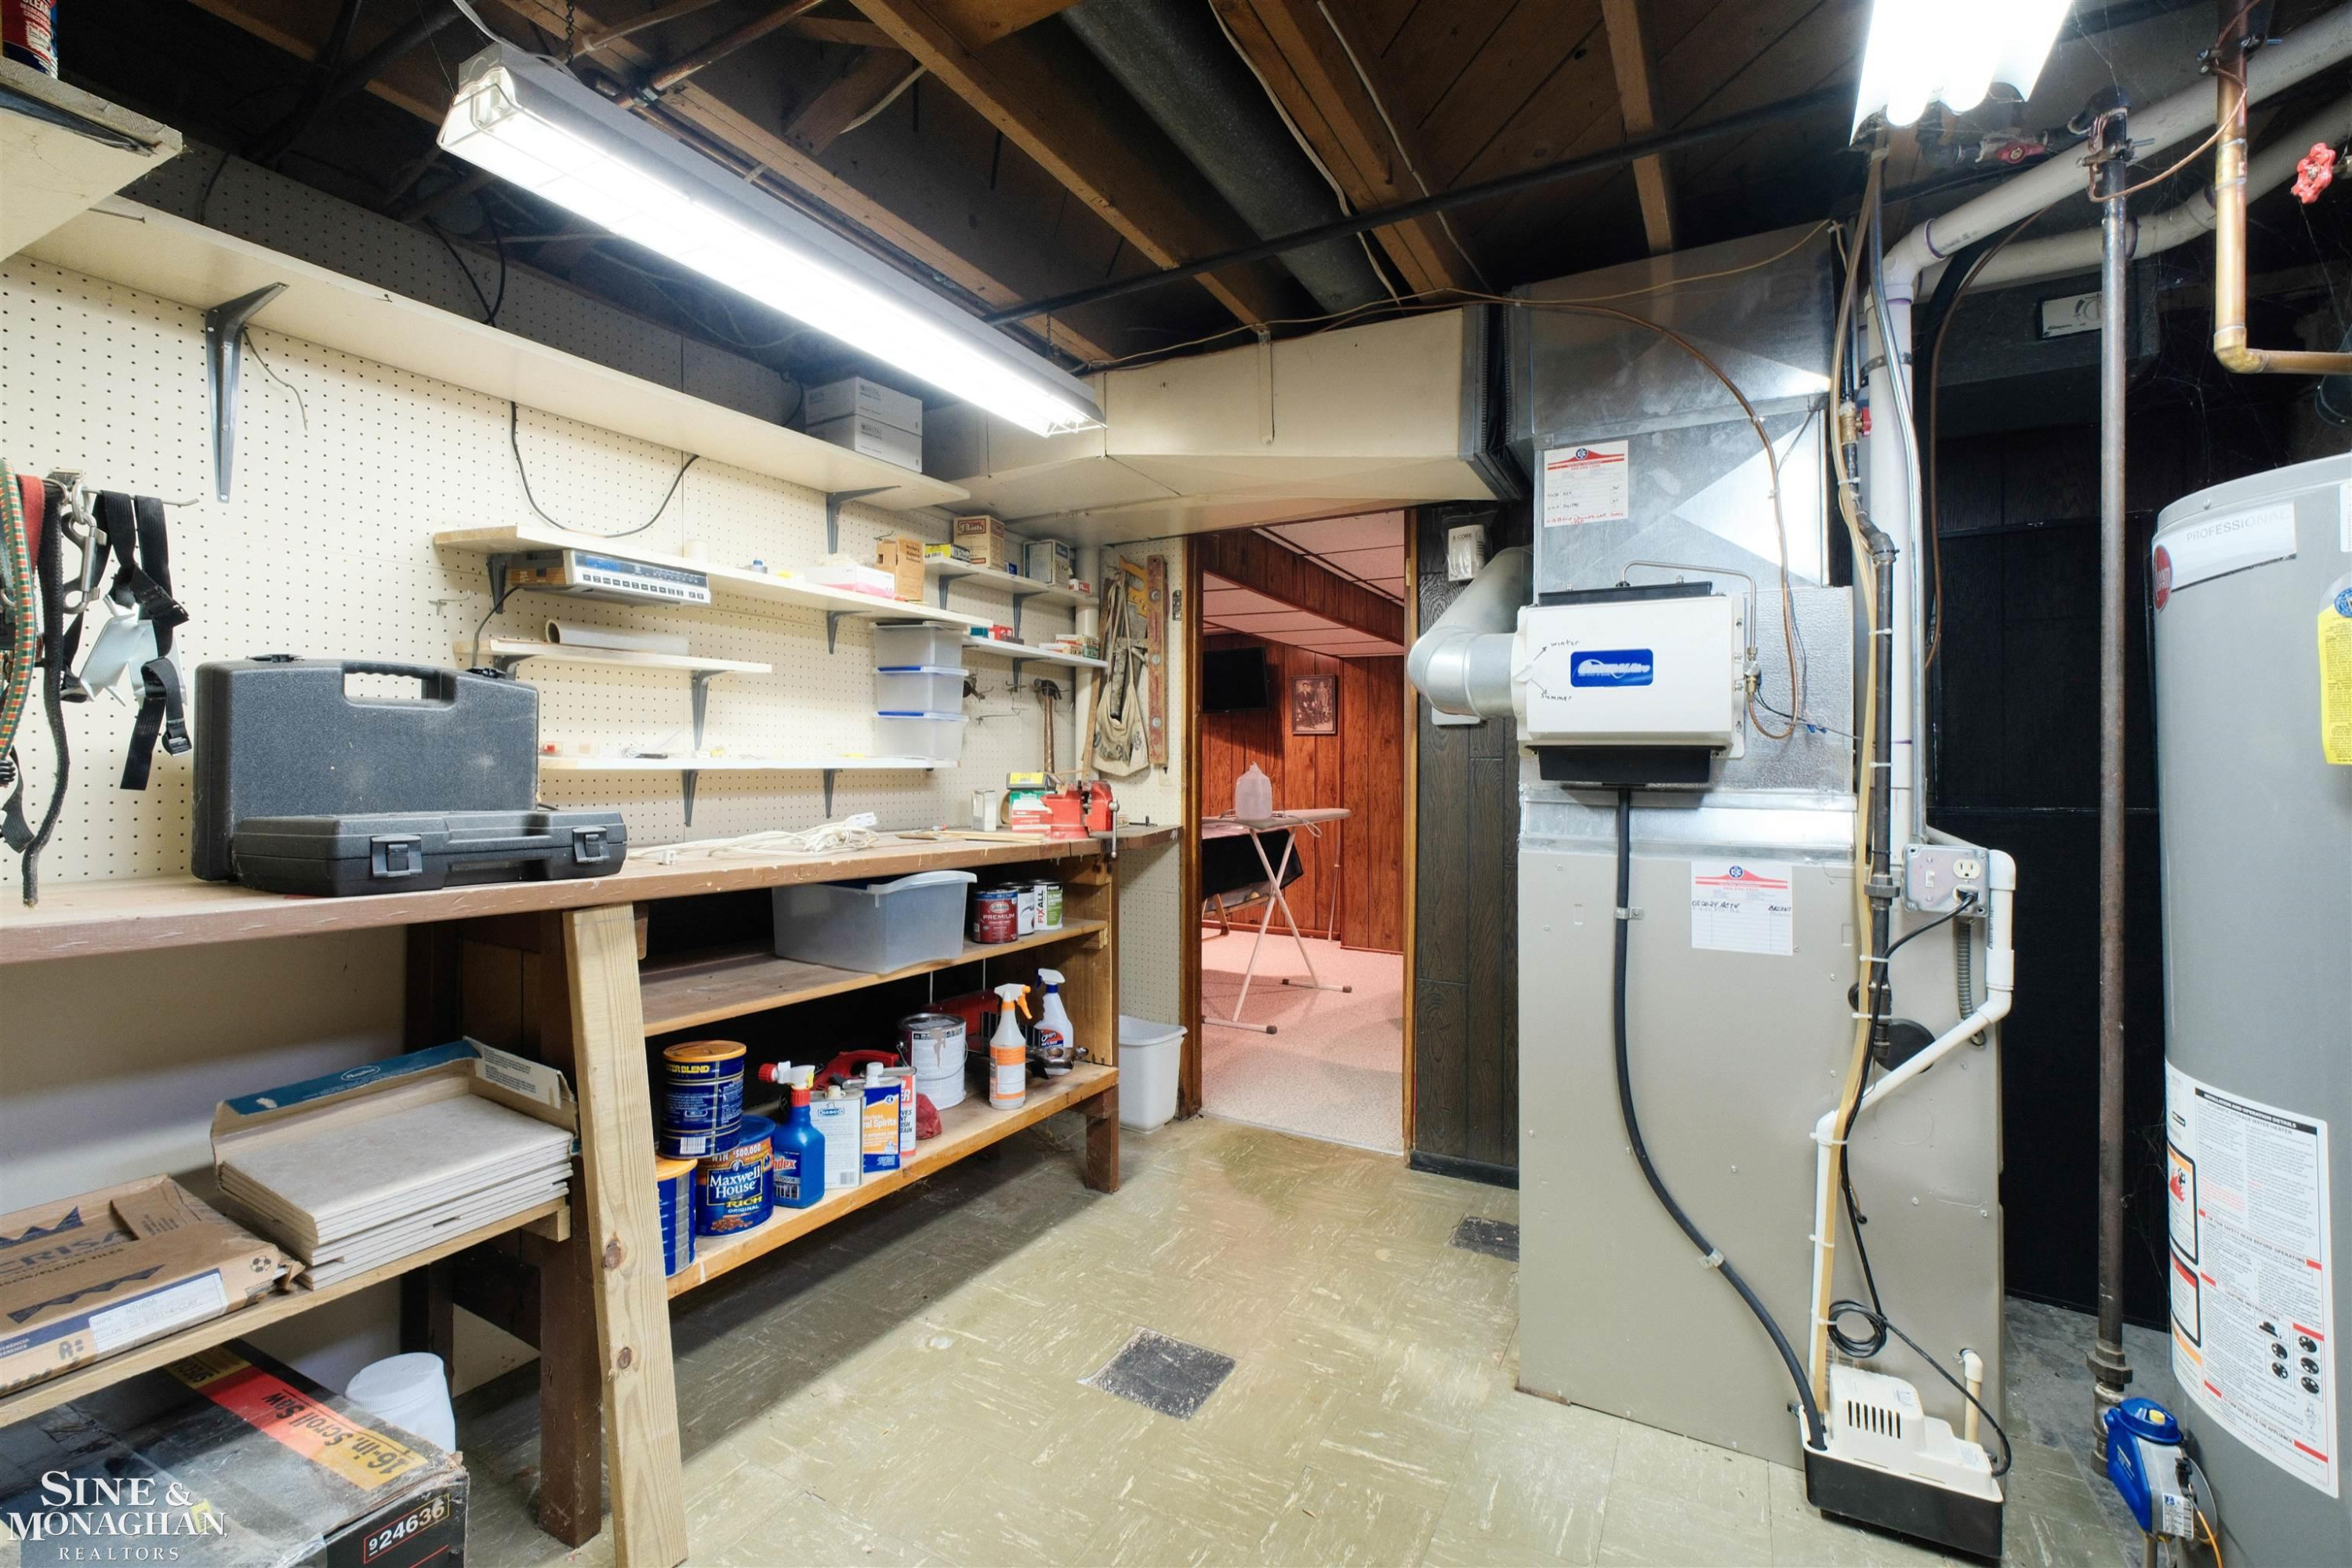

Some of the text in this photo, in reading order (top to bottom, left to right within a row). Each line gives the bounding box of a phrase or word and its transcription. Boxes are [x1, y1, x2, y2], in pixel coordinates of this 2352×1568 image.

[2187, 507, 2291, 543] PROFESSIONAL
[1541, 692, 1572, 702] summer
[681, 1065, 710, 1074] BLEND
[711, 1143, 761, 1163] WIN $500,000
[772, 1156, 797, 1170] ndex
[710, 1164, 760, 1188] Maxwell
[716, 1180, 756, 1199] House
[726, 1195, 763, 1208] RICH
[728, 1204, 760, 1214] ORIGINAL
[262, 1392, 306, 1420] Saw
[288, 1411, 354, 1447] Scroll
[368, 1497, 445, 1557] 924636
